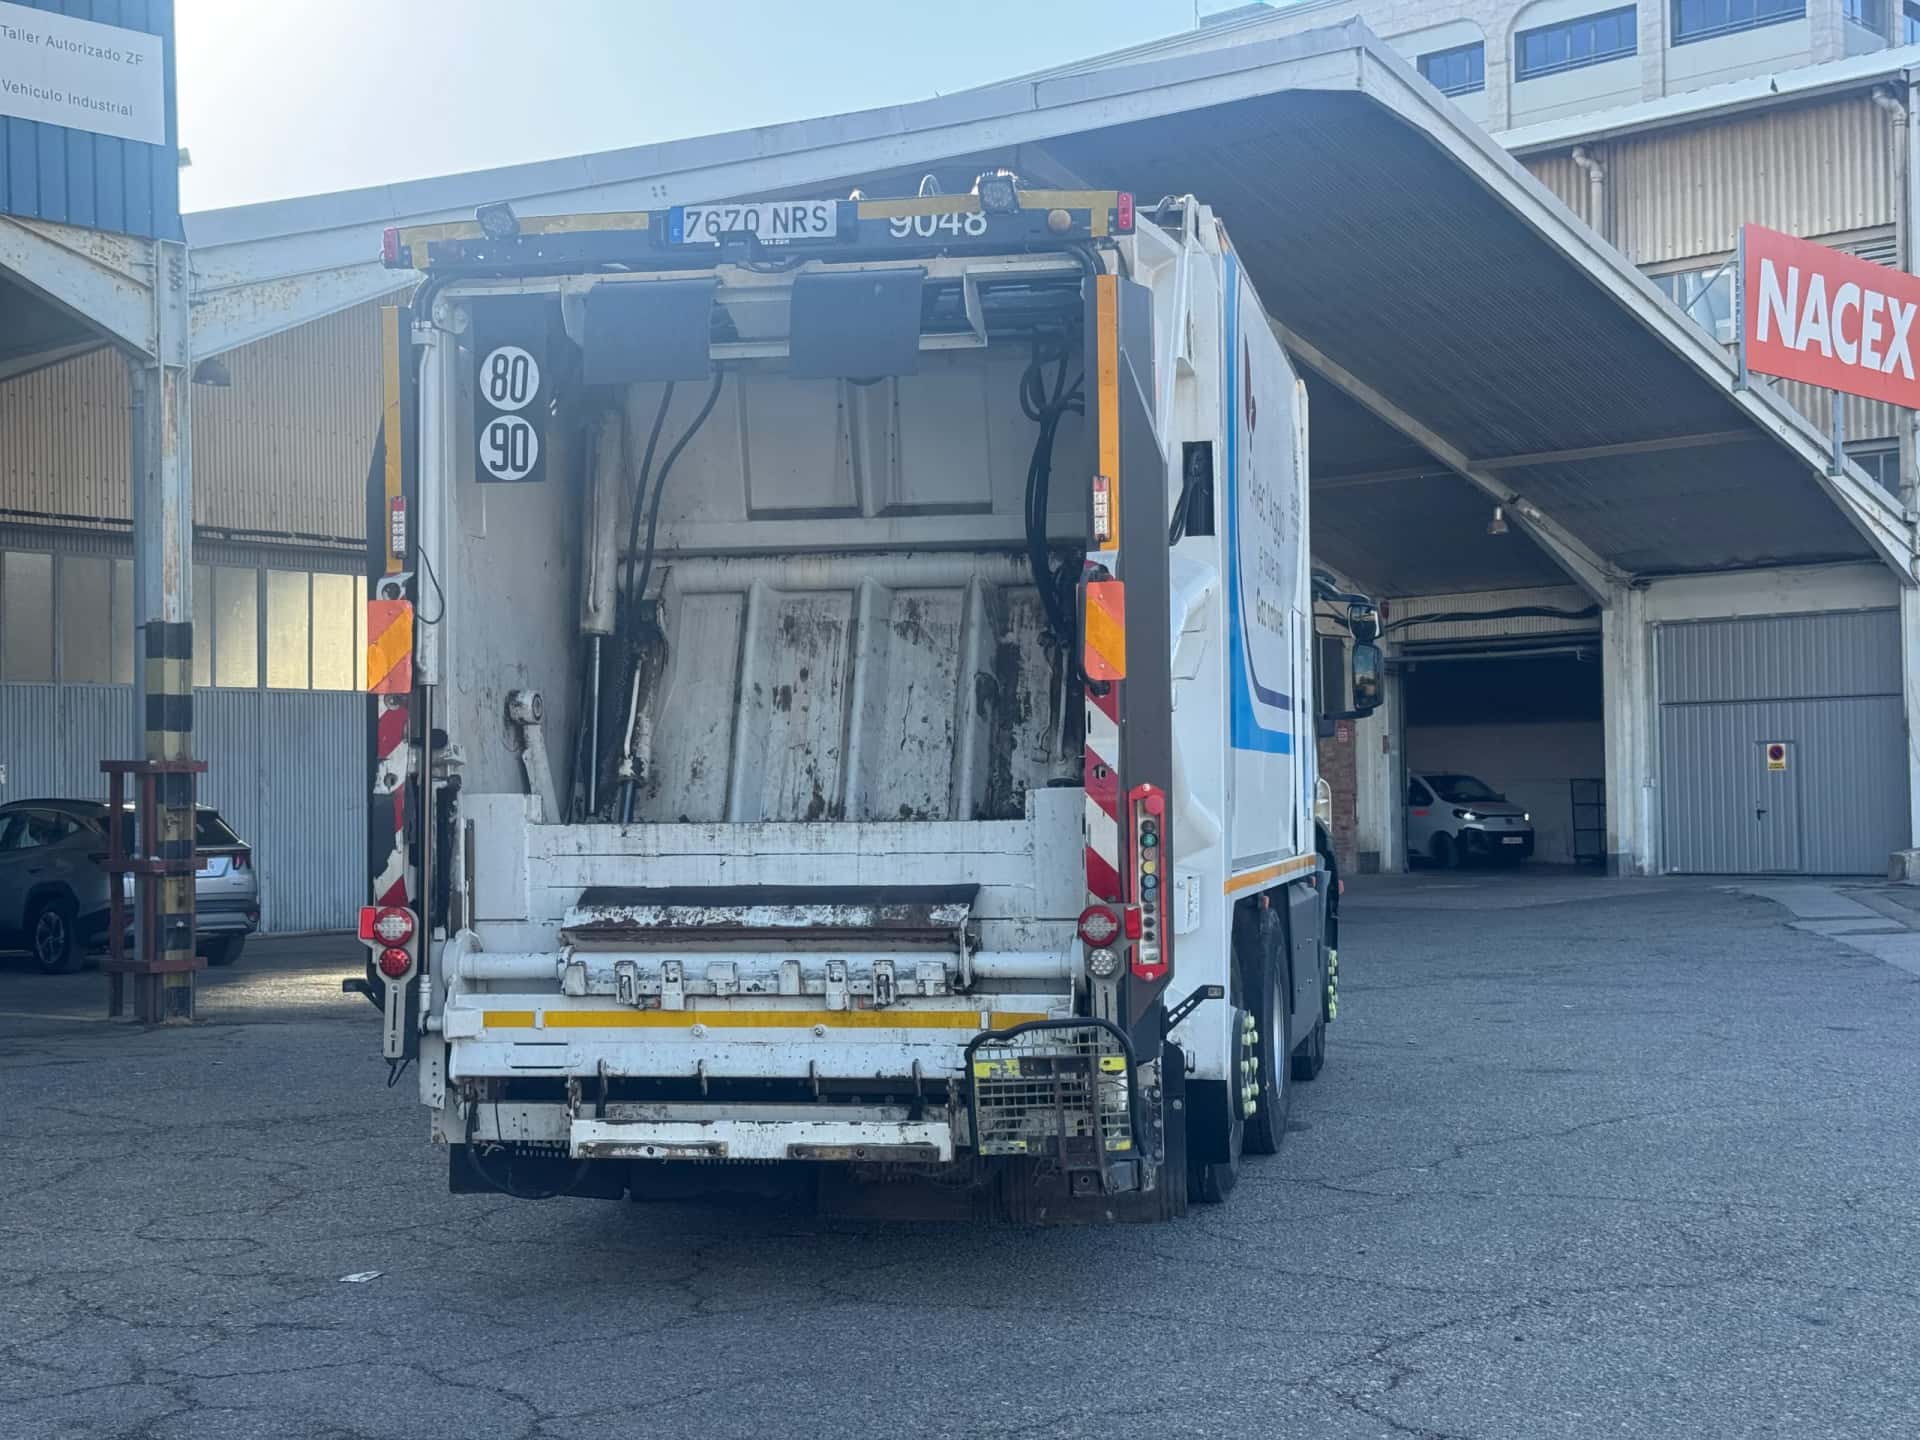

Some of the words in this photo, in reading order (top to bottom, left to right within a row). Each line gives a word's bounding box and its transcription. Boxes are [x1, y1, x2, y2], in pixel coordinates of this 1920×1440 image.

[1, 25, 40, 44] Taller
[46, 35, 121, 63] Autorizado
[126, 52, 144, 65] ZF
[69, 93, 133, 117] Industrial
[686, 209, 759, 238] 7670
[772, 205, 829, 234] NRS
[890, 211, 988, 238] 9048
[1756, 257, 1917, 380] NACEX
[490, 353, 529, 403] 80
[490, 422, 529, 472] 90
